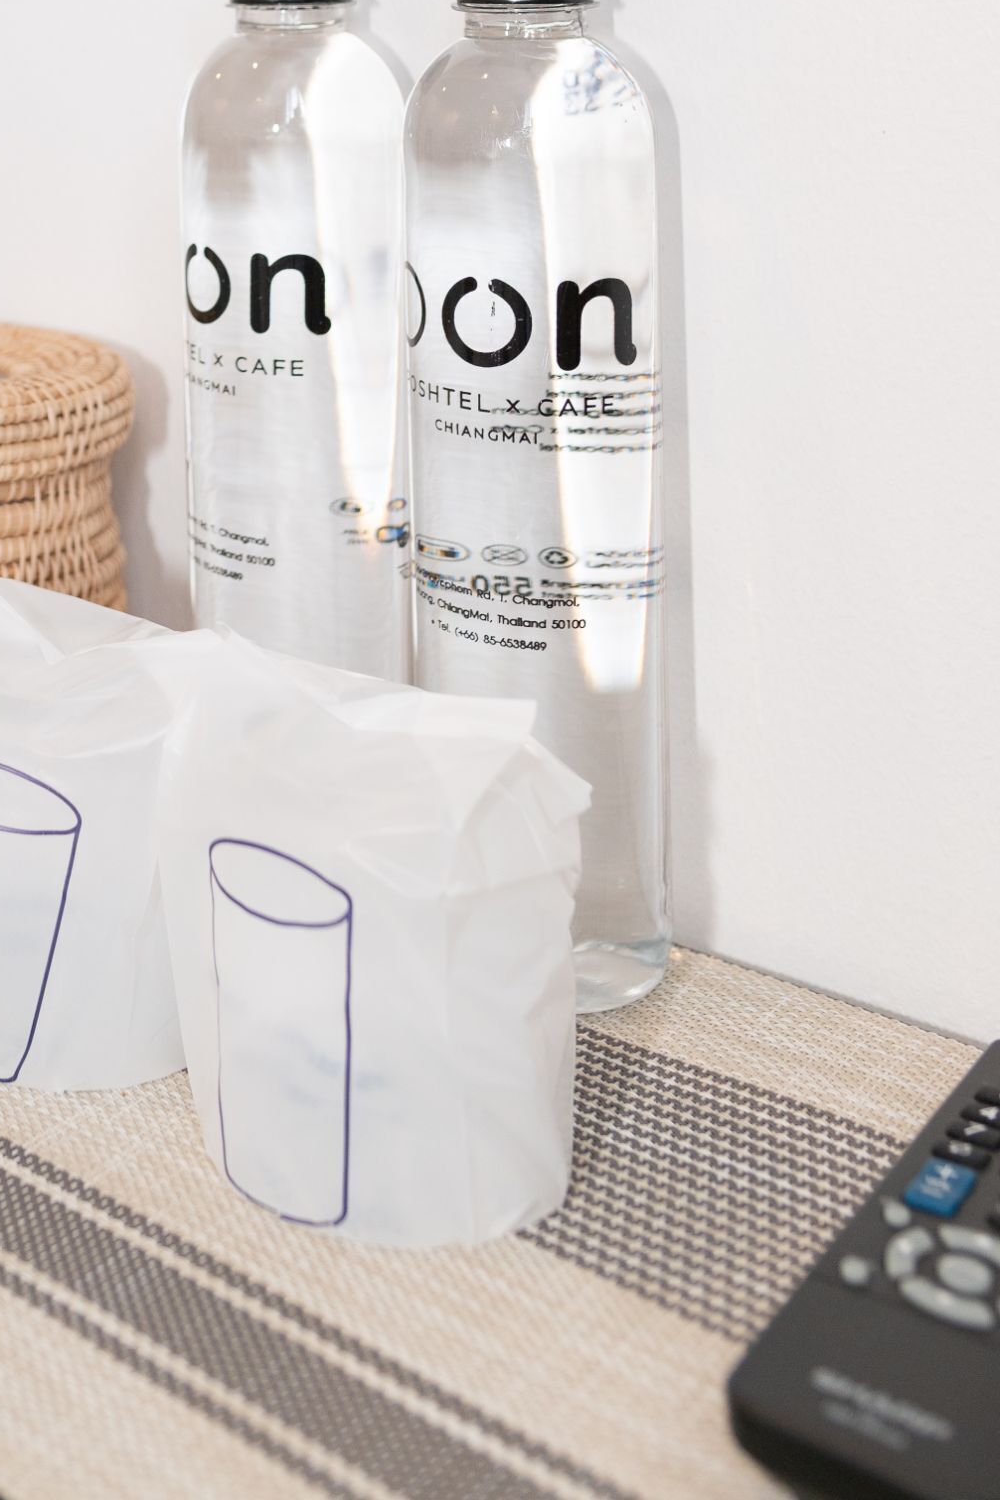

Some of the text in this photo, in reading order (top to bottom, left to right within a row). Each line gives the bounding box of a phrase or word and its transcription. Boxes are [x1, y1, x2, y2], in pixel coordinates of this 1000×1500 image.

[235, 356, 304, 376] CAFE
[409, 374, 491, 414] OSHTEL
[538, 395, 615, 417] CAFE
[434, 419, 539, 445] CHIANGMAI
[497, 613, 547, 629] Thailand
[551, 618, 587, 630] 50100
[483, 634, 548, 651] 85-6538489
